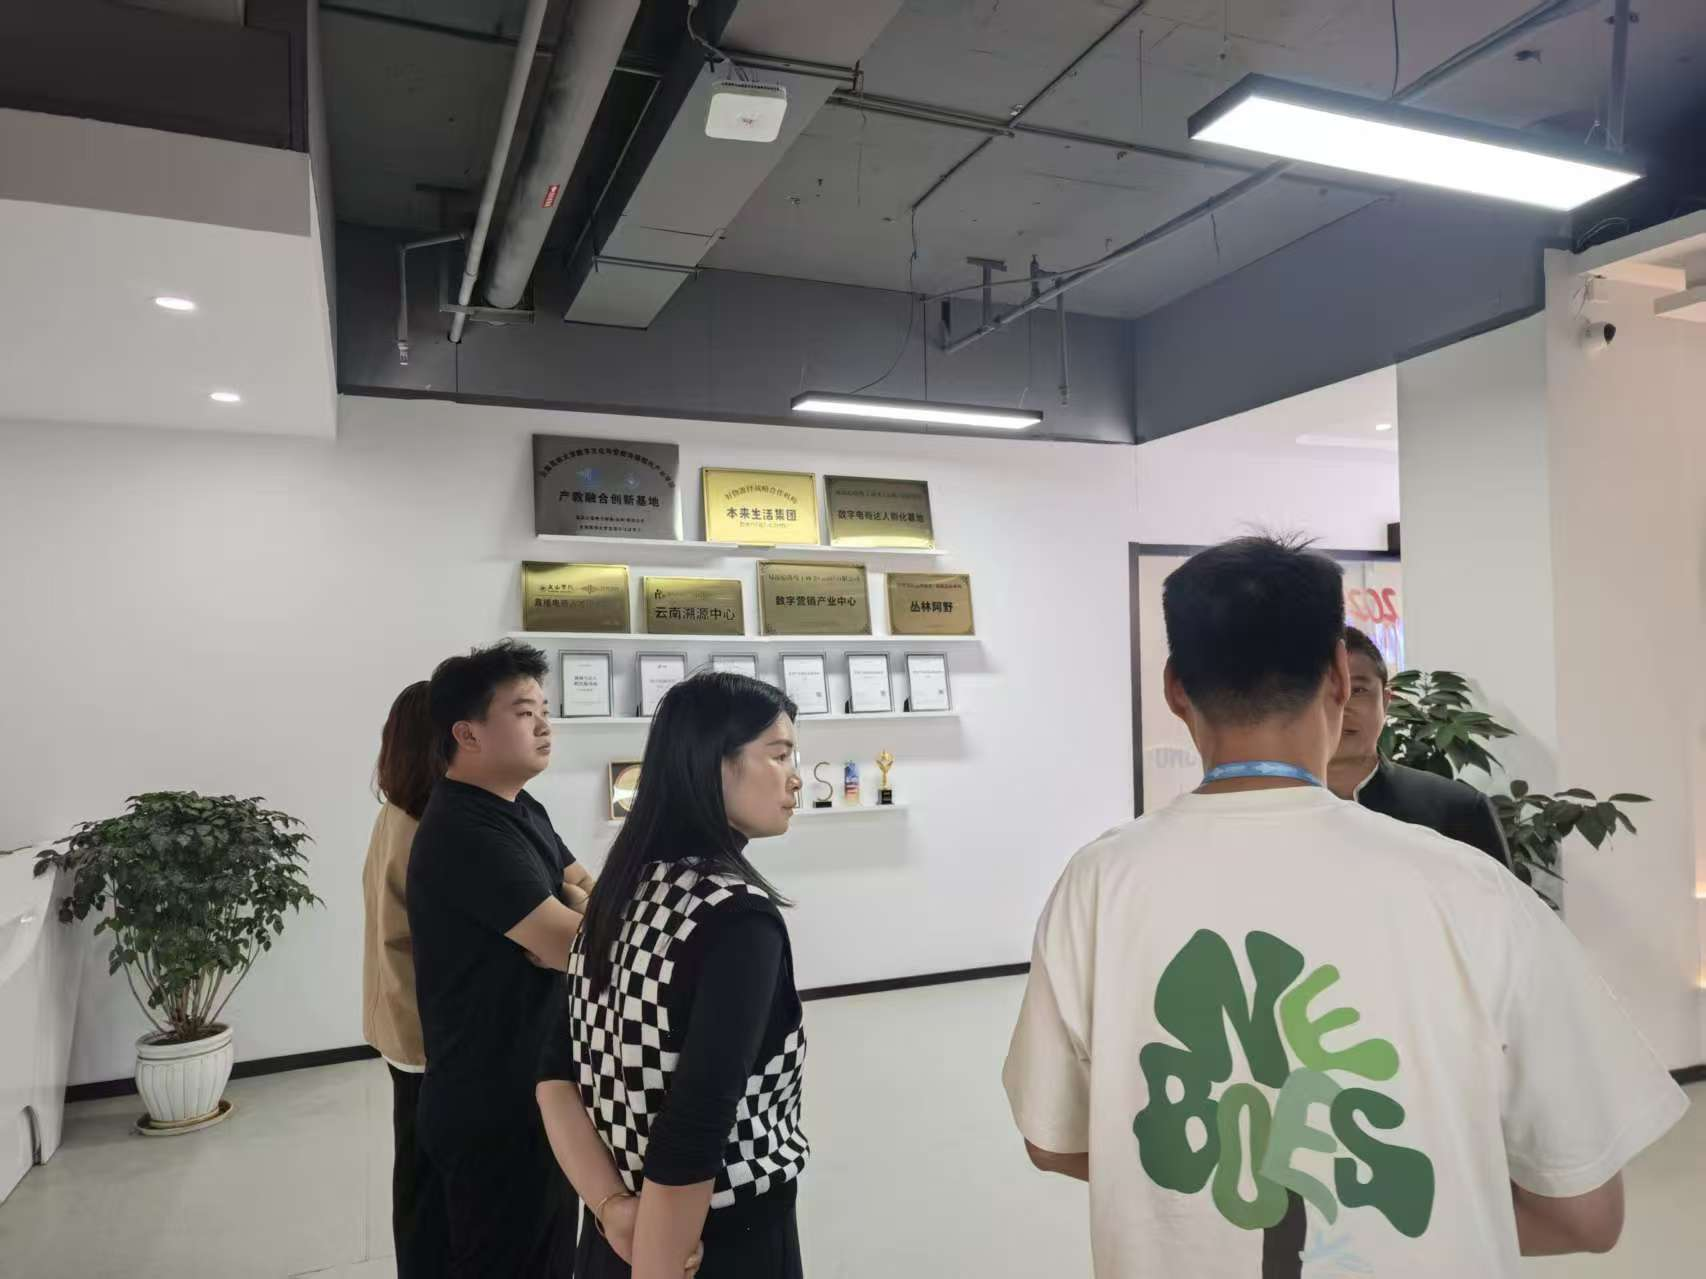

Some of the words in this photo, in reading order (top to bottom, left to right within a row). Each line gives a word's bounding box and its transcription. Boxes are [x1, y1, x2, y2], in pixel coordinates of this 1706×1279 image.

[558, 490, 660, 507] 产教融合创新基地
[726, 506, 797, 521] 本来生活集团
[775, 595, 857, 607] 数字营销产业中心
[654, 606, 737, 620] 云南溯源中心
